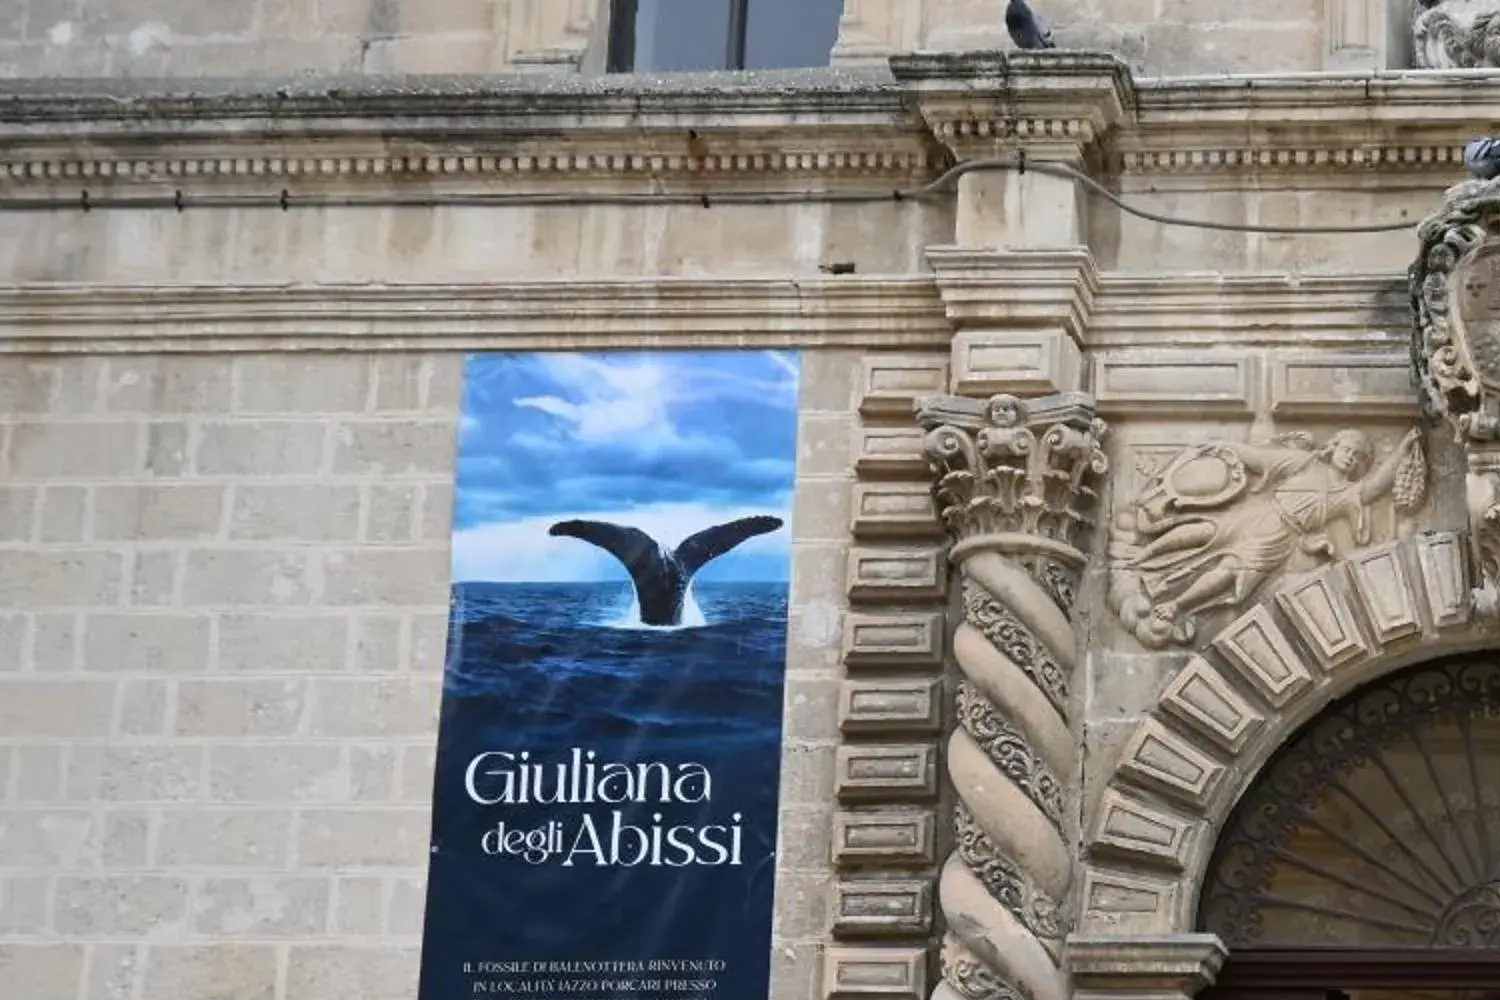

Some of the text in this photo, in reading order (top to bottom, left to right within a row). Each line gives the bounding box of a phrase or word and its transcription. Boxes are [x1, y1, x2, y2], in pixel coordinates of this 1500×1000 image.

[465, 748, 711, 804] Giuliana
[481, 810, 743, 866] degli Abissi
[478, 961, 530, 973] FOSSILE
[533, 961, 547, 973] DI
[550, 960, 644, 973] BALENOTTERA
[648, 959, 728, 972] RINVENUTO
[473, 980, 487, 993] IN
[601, 979, 661, 991] PORCARI
[665, 979, 718, 991] PRESSO
